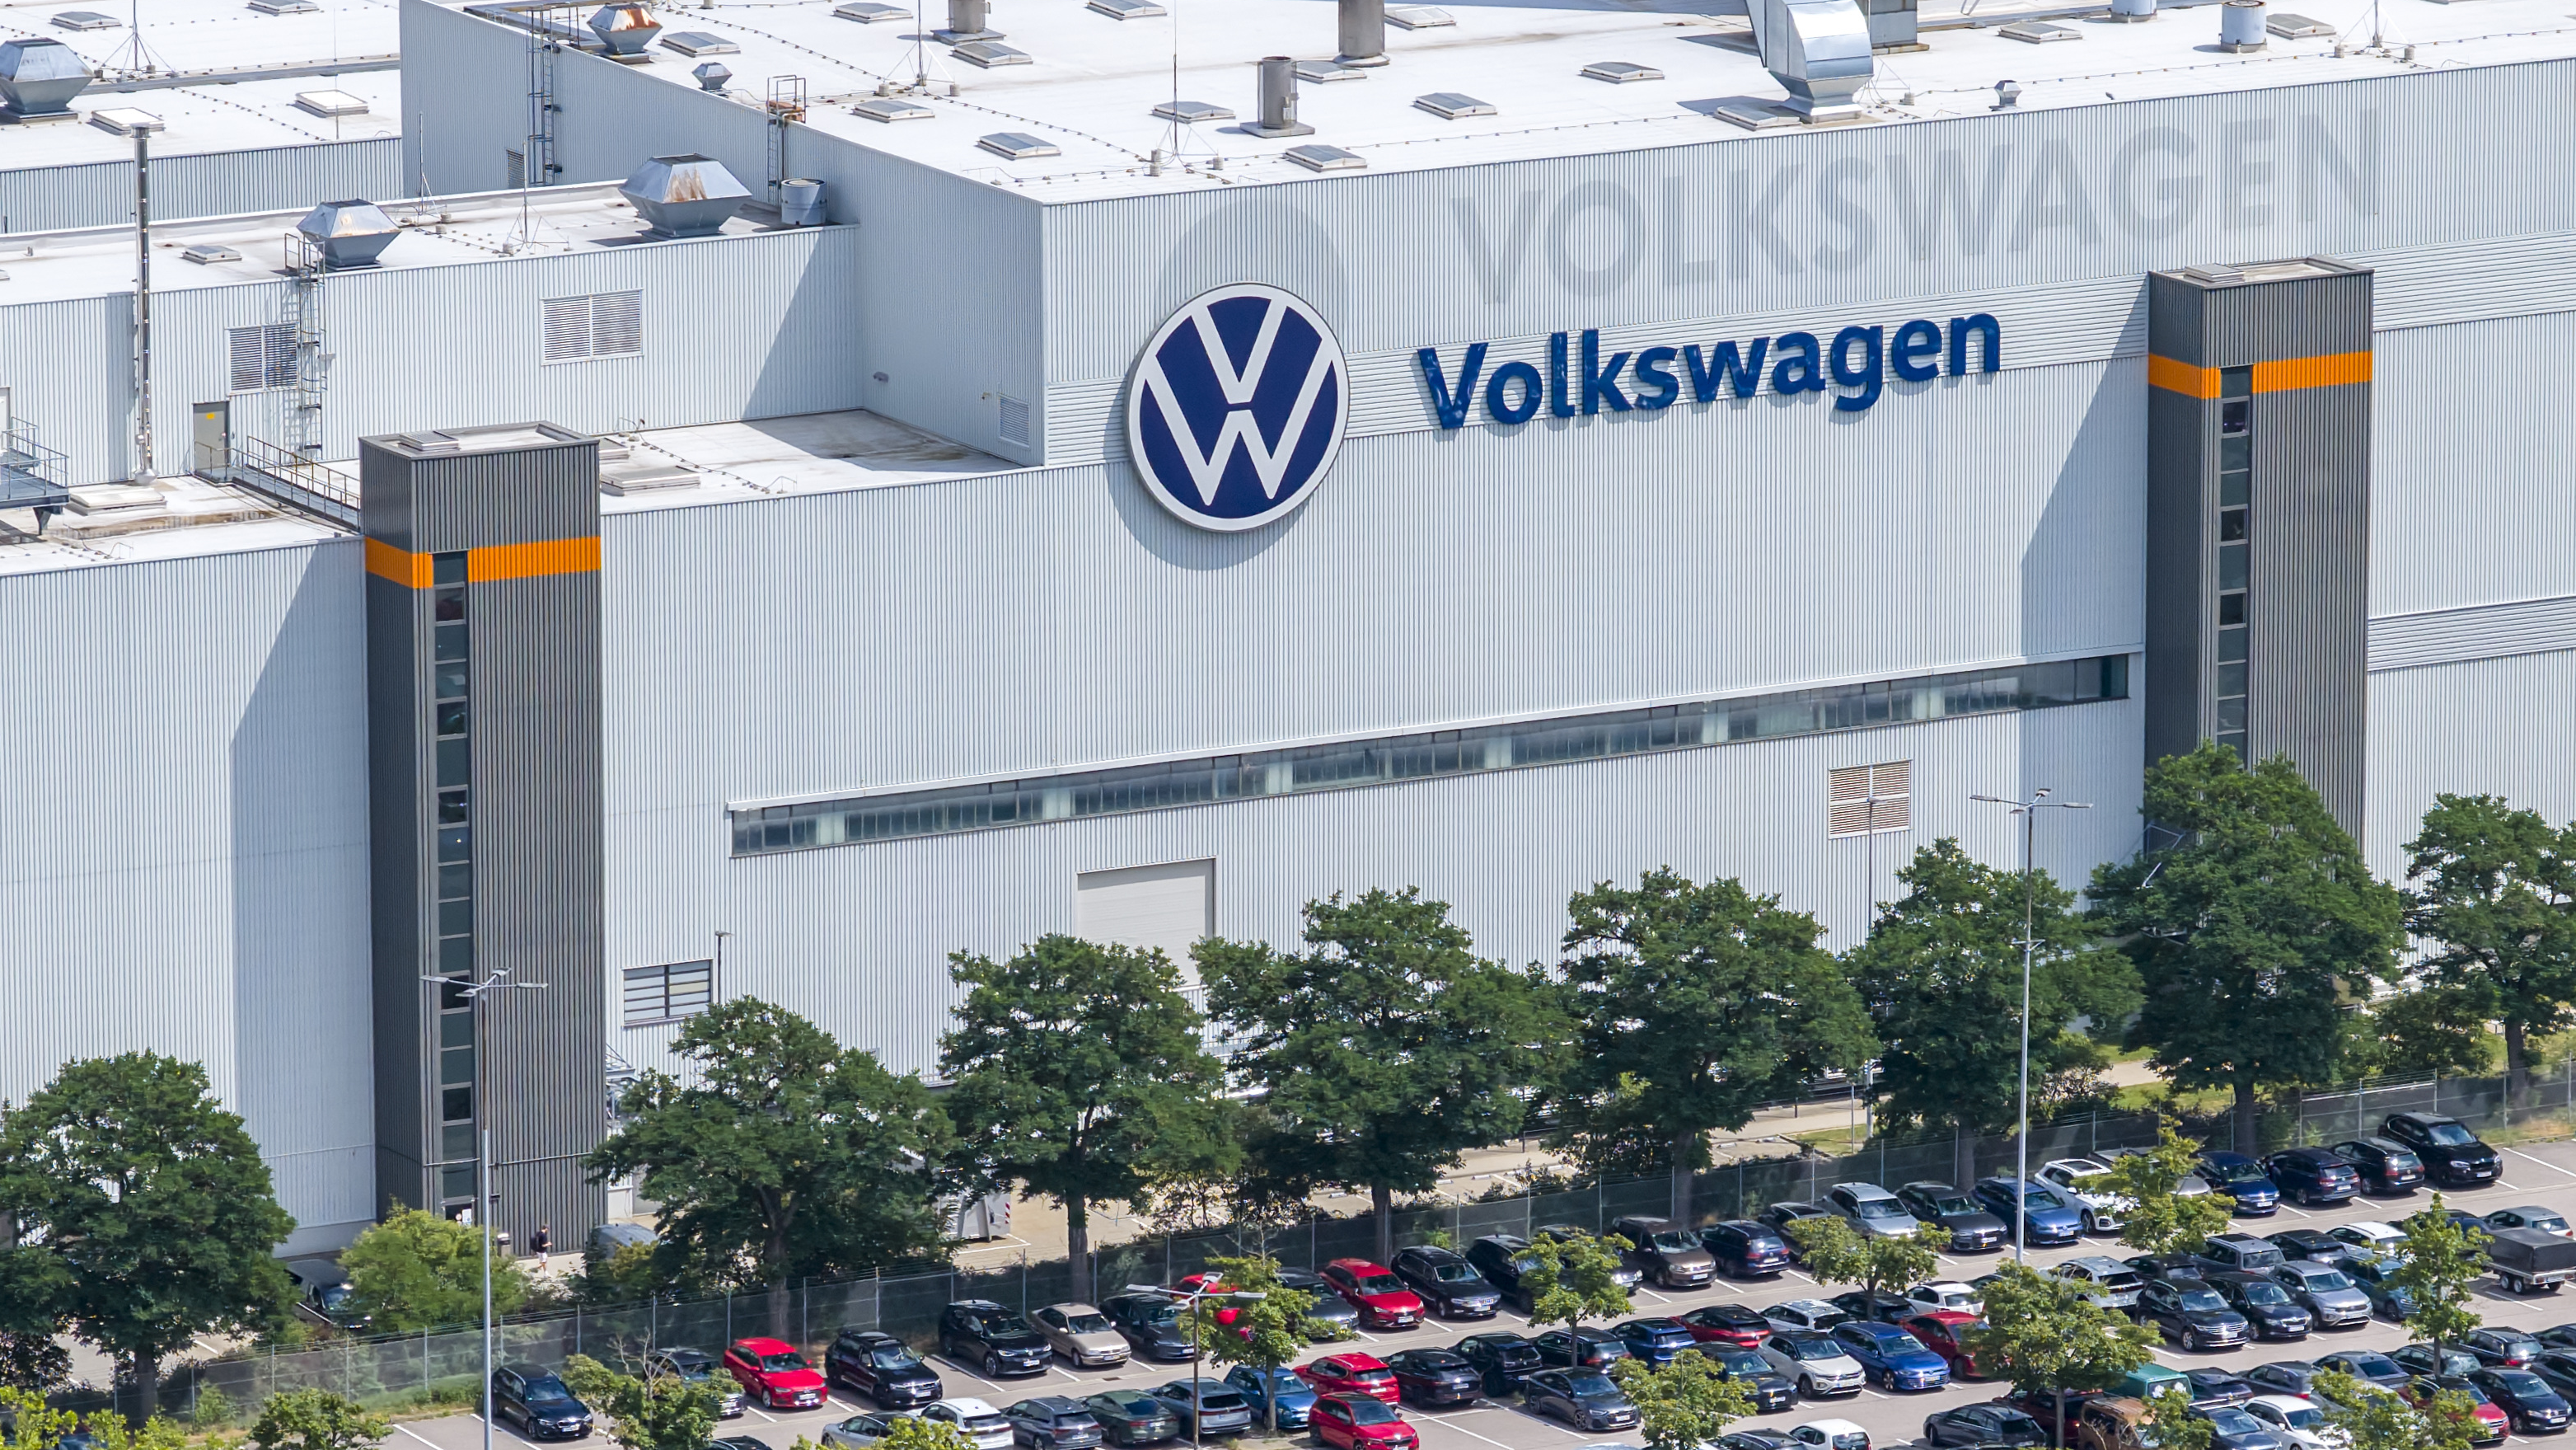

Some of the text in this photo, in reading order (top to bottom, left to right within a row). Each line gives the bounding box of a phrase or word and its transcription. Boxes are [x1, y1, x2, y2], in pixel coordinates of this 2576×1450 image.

[1449, 108, 2379, 304] VOLKSWAGEN
[1134, 287, 1343, 508] VW
[1417, 313, 2001, 430] Volkswagen
